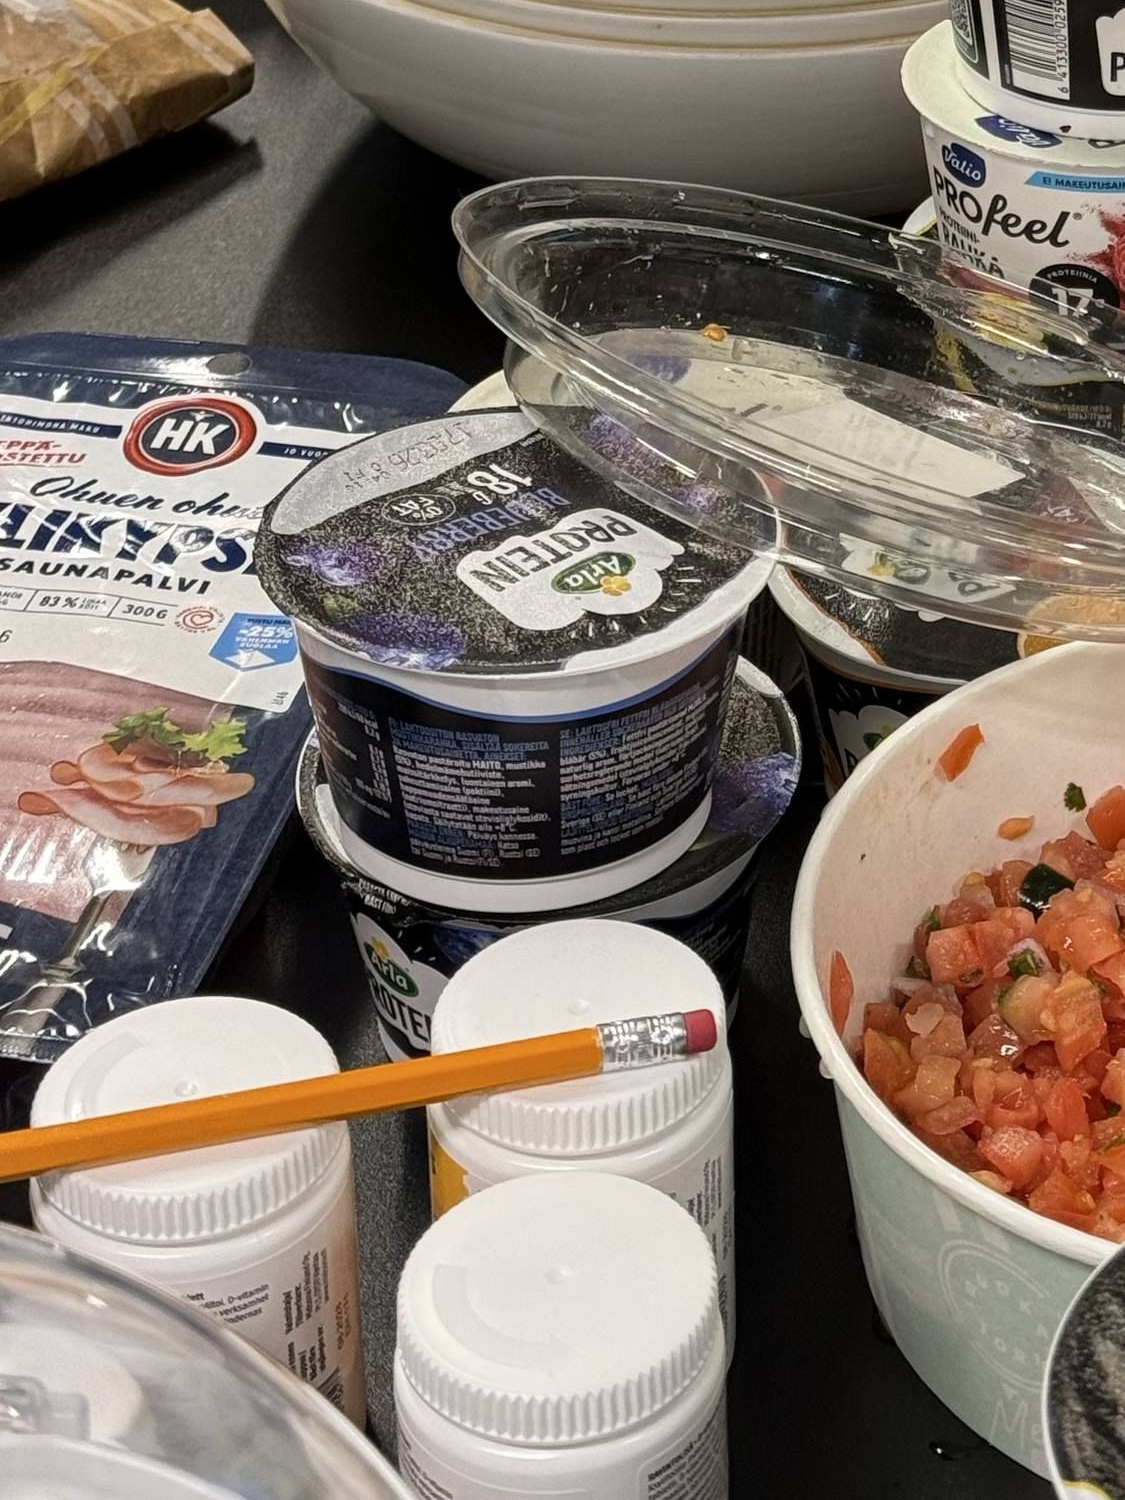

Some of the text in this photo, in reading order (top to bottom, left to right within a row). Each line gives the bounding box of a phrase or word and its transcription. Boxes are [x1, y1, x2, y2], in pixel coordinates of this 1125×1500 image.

[945, 150, 982, 182] Valio
[149, 418, 231, 456] HK
[0, 452, 87, 463] STETTU
[29, 476, 164, 511] Ohuen
[465, 462, 533, 497] 18
[0, 501, 258, 574] LIKYPS
[469, 509, 640, 592] PROTEIN
[0, 557, 212, 596] SAUNAPALVI
[565, 555, 622, 589] Arla
[39, 595, 61, 608] 83
[122, 603, 154, 618] 300
[156, 609, 169, 620] G
[238, 625, 293, 638] -25%
[371, 950, 410, 991] Arla
